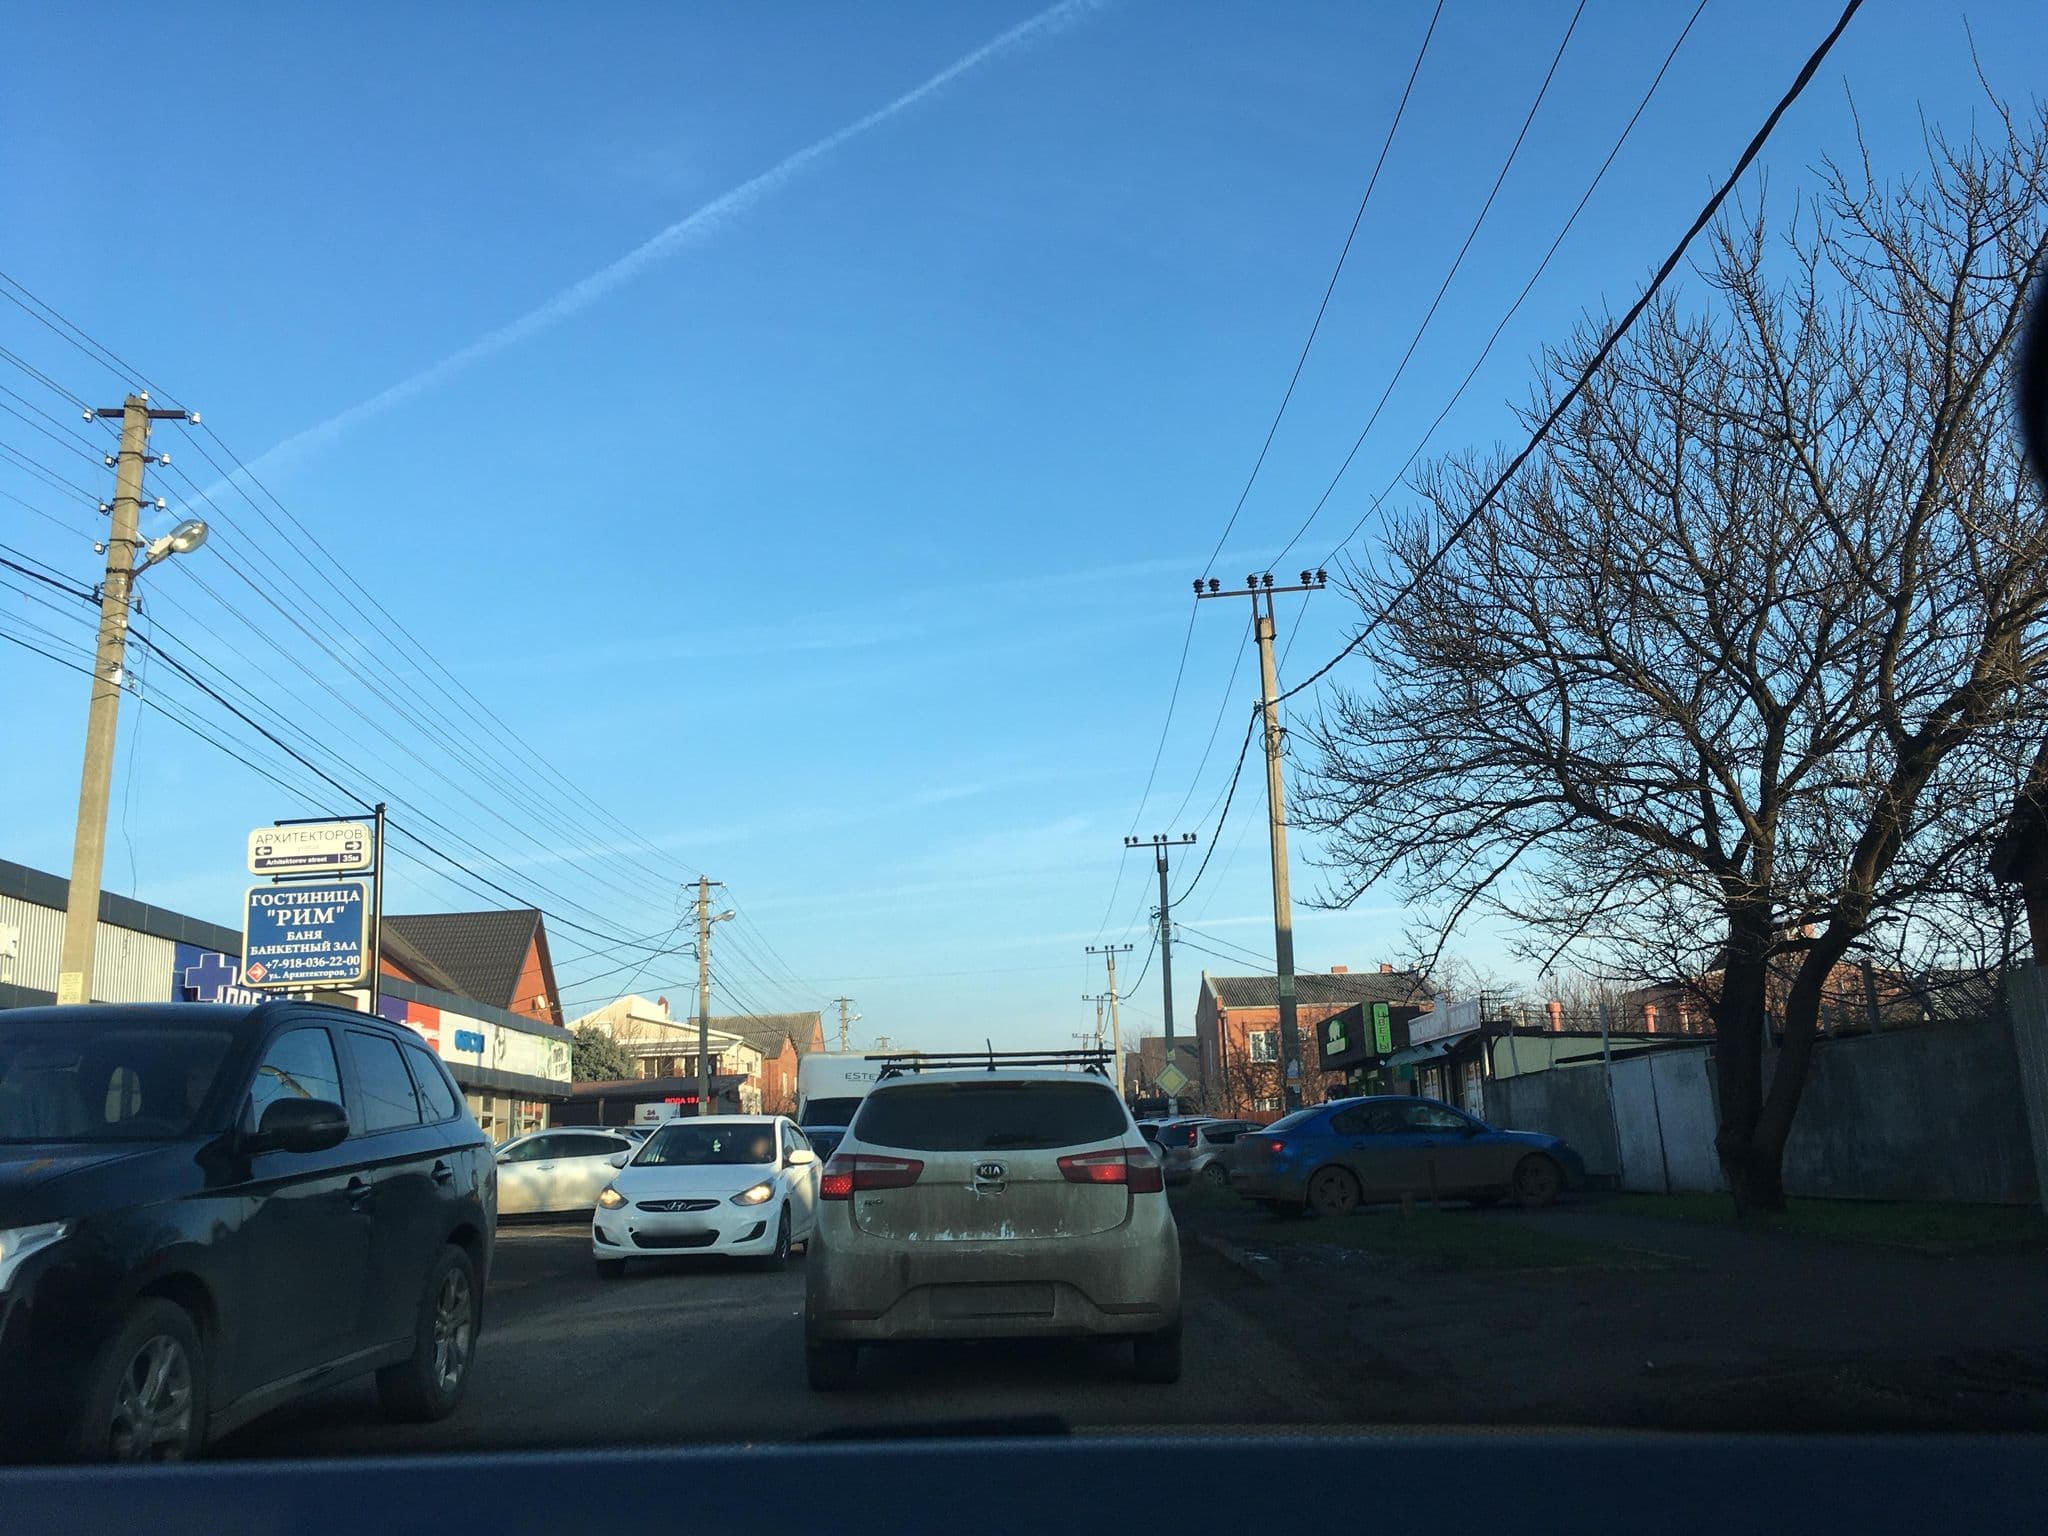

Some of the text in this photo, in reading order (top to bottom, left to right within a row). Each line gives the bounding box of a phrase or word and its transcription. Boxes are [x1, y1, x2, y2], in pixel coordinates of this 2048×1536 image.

[255, 829, 363, 844] АРХИТЕКТОРОВ
[251, 890, 360, 906] ГОСТИНИЦА
[267, 906, 345, 926] "РИМ"
[286, 930, 322, 941] БАНЯ
[250, 941, 358, 956] БАНКЕТНЫЙ ЗАЛ
[265, 956, 360, 969] +7-918-036-22-00
[349, 968, 360, 976] 13
[980, 1165, 1001, 1176] KIA
